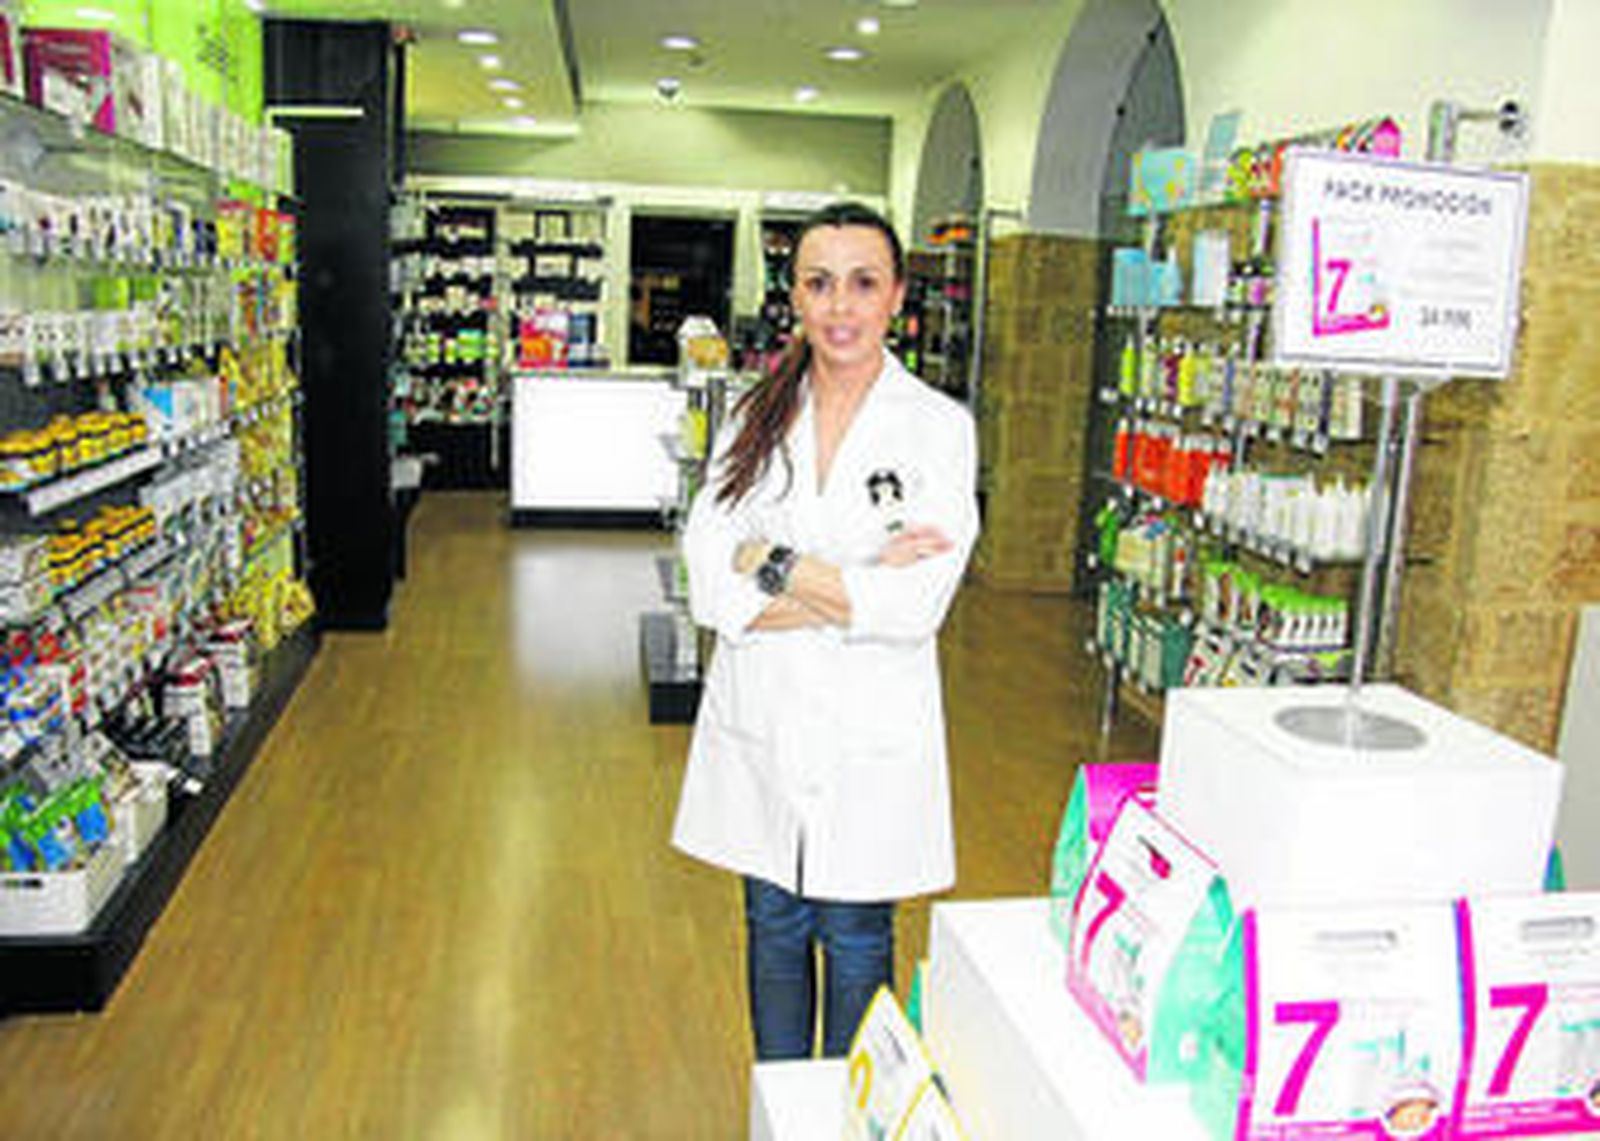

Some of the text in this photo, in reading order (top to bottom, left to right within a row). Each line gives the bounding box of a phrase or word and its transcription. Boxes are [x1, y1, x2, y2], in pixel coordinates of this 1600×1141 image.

[1326, 259, 1352, 313] 7
[1273, 1000, 1339, 1116] 7
[1488, 983, 1548, 1097] 7
